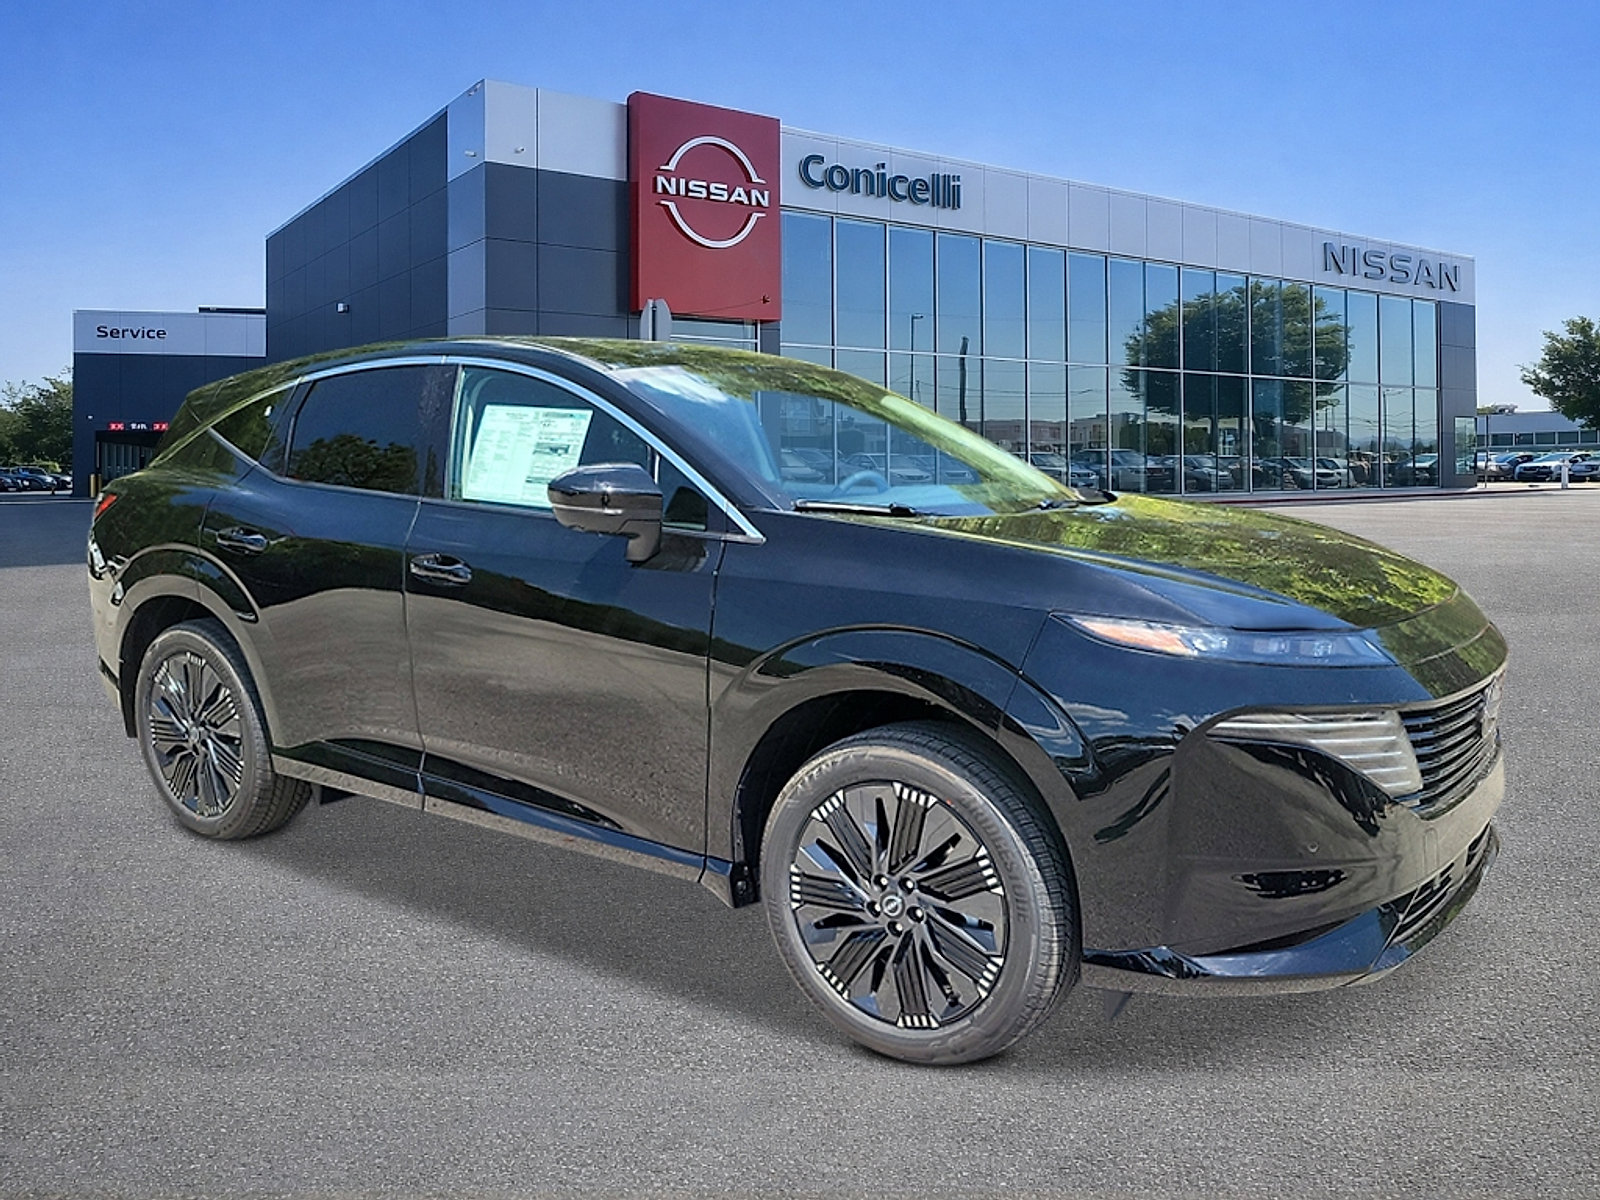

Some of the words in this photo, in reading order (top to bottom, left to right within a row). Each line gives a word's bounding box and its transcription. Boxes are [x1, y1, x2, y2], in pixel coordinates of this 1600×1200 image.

[655, 174, 770, 207] NISSAN
[799, 154, 962, 210] Conicelli
[1323, 241, 1461, 292] NISSAN
[96, 324, 167, 339] Service
